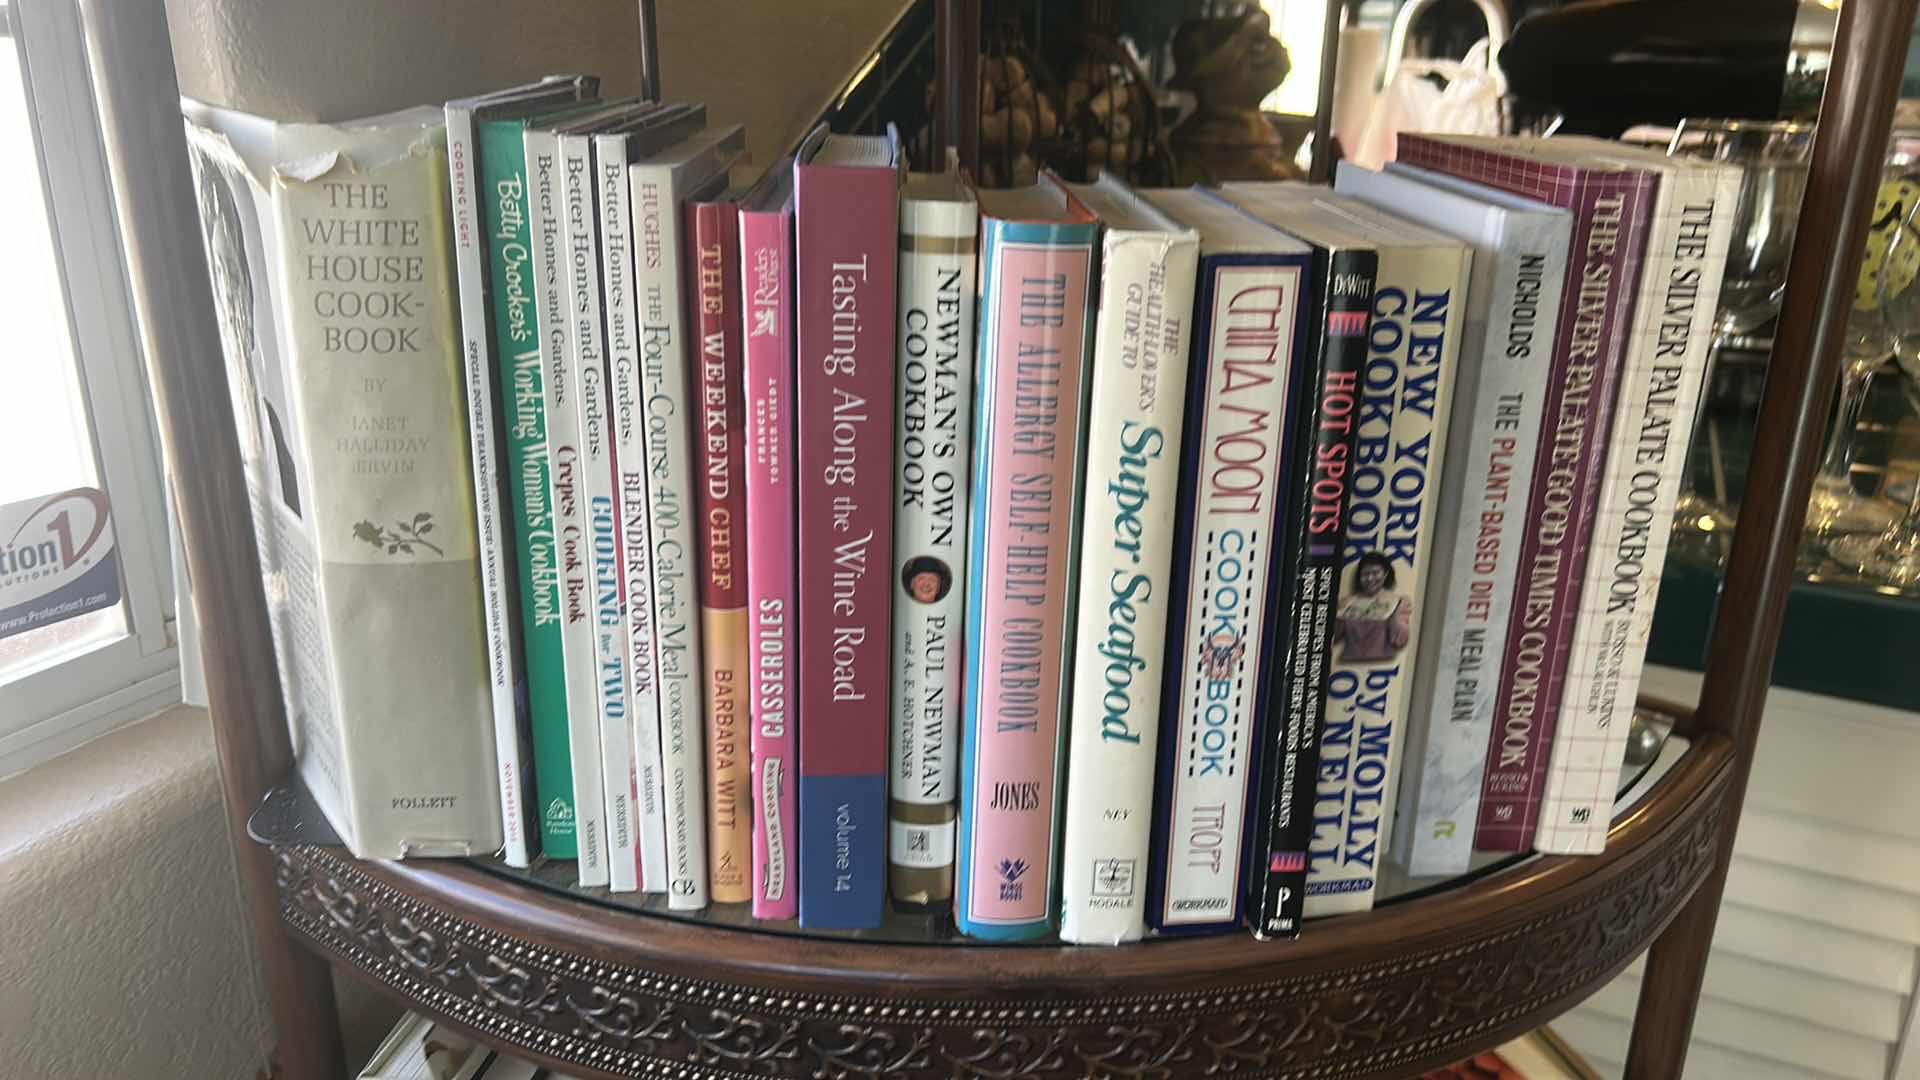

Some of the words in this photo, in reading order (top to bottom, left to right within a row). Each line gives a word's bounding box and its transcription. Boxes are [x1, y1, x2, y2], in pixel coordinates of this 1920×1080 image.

[323, 183, 389, 209] THE
[453, 142, 467, 205] COOKING
[496, 172, 523, 239] Betty
[538, 154, 554, 216] Better
[567, 157, 585, 229] Better
[605, 162, 621, 230] Better
[301, 219, 419, 247] WHITE
[459, 209, 471, 249] LIGHT
[542, 217, 559, 286] Homes
[642, 183, 662, 270] HUGHES
[1586, 191, 1625, 258] THE
[1674, 199, 1715, 260] THE
[306, 255, 423, 281] HOUSE
[313, 291, 424, 320] COOK-
[502, 242, 533, 342] Crocker's
[573, 231, 592, 313] Homes
[608, 232, 626, 308] Homes
[647, 284, 662, 321] THE
[700, 244, 724, 315] THE
[1020, 273, 1067, 329] THE
[322, 327, 421, 355] BOOK
[550, 289, 565, 326] and
[579, 319, 598, 361] and
[613, 312, 631, 351] and
[823, 253, 868, 377] Tasting
[1123, 282, 1143, 341] GUIDE
[1163, 318, 1181, 357] THE
[1219, 284, 1284, 394] CHINA
[1505, 253, 1546, 360] NICHOLDS
[1567, 262, 1613, 360] SILVER
[1655, 266, 1702, 359] SILVER
[363, 377, 387, 393] BY
[932, 266, 961, 459] NEWMAN'S
[1122, 343, 1138, 370] TO
[1400, 287, 1451, 421] NEW
[512, 348, 546, 441] Working
[643, 322, 676, 480] Four-Course
[703, 330, 729, 500] WEEKEND
[755, 398, 767, 465] FRANCES
[902, 307, 929, 510] COOKBOOK
[1012, 341, 1061, 464] ALLERGY
[1319, 370, 1358, 437] HOT
[1343, 285, 1408, 568] COOKBOOK
[1494, 391, 1525, 430] THE
[1550, 364, 1596, 467] PALATE
[1635, 365, 1683, 464] PALATE
[823, 387, 868, 487] Along
[1208, 403, 1271, 514] MOON
[521, 441, 555, 528] Woman's
[554, 445, 578, 518] Crepes
[832, 495, 858, 532] the
[929, 470, 955, 548] OWN
[1108, 420, 1164, 564] Super
[1307, 441, 1349, 535] SPOTS
[1384, 430, 1434, 570] YORK
[1472, 435, 1518, 575] PLANT-BASED
[1538, 467, 1578, 546] GOOD
[563, 525, 583, 574] Cook
[622, 471, 646, 573] BLENDER
[654, 485, 686, 619] 400-Calorie
[709, 507, 733, 591] CHEF
[1004, 472, 1055, 606] SELF-HELP
[1605, 469, 1662, 615] COOKBOOK
[528, 529, 563, 627] Cookbook
[591, 497, 620, 626] COOKING
[832, 528, 874, 617] Wine
[1212, 529, 1245, 638] COOK
[1319, 566, 1333, 602] SPICY
[1519, 549, 1562, 630] TIMES
[567, 578, 587, 626] Book
[629, 578, 649, 635] COOK
[1311, 603, 1328, 652] RECIPES
[1465, 579, 1496, 622] DIET
[633, 640, 653, 697] BOOK
[659, 622, 689, 680] Meal
[759, 599, 785, 738] CASSEROLES
[832, 626, 866, 703] Road
[904, 631, 914, 655] and
[924, 615, 946, 679] PAUL
[997, 617, 1045, 733] COOKBOOK
[1098, 569, 1153, 745] Seafood
[1294, 602, 1313, 677] CELEBRATED
[1306, 652, 1323, 688] FROM
[1456, 627, 1488, 677] MEAL
[602, 656, 626, 719] TWO
[714, 669, 736, 770] BARBARA
[1301, 687, 1319, 749] AMERICA'S
[1354, 663, 1400, 717] by
[1450, 678, 1477, 723] PLAN
[1499, 631, 1549, 769] COOKBOOK
[901, 696, 915, 780] HOTCHNER
[921, 681, 944, 799] NEWMAN
[1199, 679, 1233, 778] BOOK
[716, 779, 738, 830] WITT
[765, 761, 778, 818] COOKING
[990, 781, 1040, 811] JONES
[1278, 752, 1298, 829] RESTAURANTS
[1307, 669, 1360, 875] O'NEILL
[1343, 719, 1393, 871] MOLLY
[769, 823, 782, 898] HEARTLAND
[835, 802, 857, 872] volume
[1186, 801, 1227, 877] TROPP
[834, 873, 852, 892] 14
